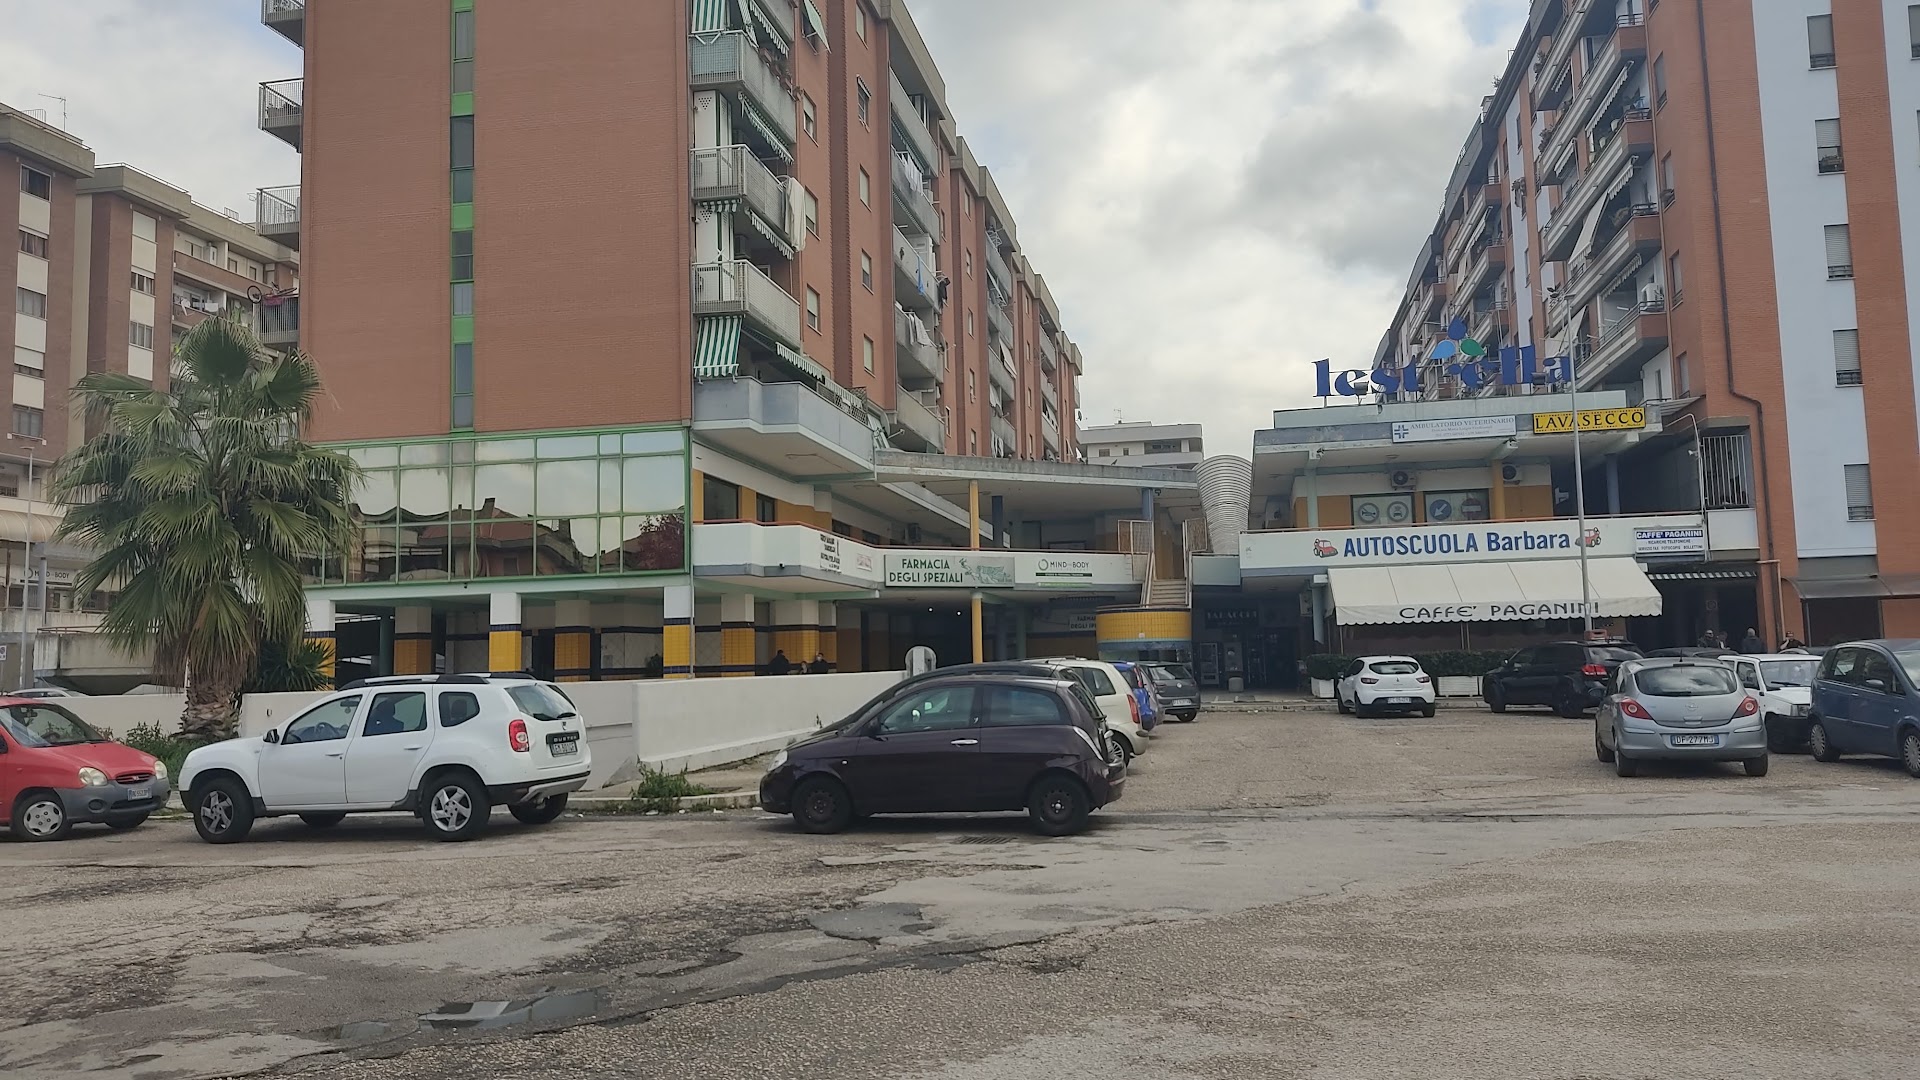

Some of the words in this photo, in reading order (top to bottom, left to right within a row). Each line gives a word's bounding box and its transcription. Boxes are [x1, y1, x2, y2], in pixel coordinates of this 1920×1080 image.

[1410, 420, 1463, 430] AMBULATORIO
[1463, 417, 1515, 427] VETERINARIO
[1536, 411, 1643, 429] LAVASECCO
[1637, 531, 1664, 539] CAFFE'
[1665, 530, 1702, 538] PAGANINI
[1343, 532, 1479, 558] AUTOSCUOLA
[1486, 530, 1570, 552] Barbara
[902, 558, 950, 570] FARMACIA
[889, 572, 920, 583] DEGLI
[923, 572, 963, 583] SPEZIALI
[1399, 605, 1477, 619] CAFFE'
[1491, 601, 1599, 617] PAGANINI
